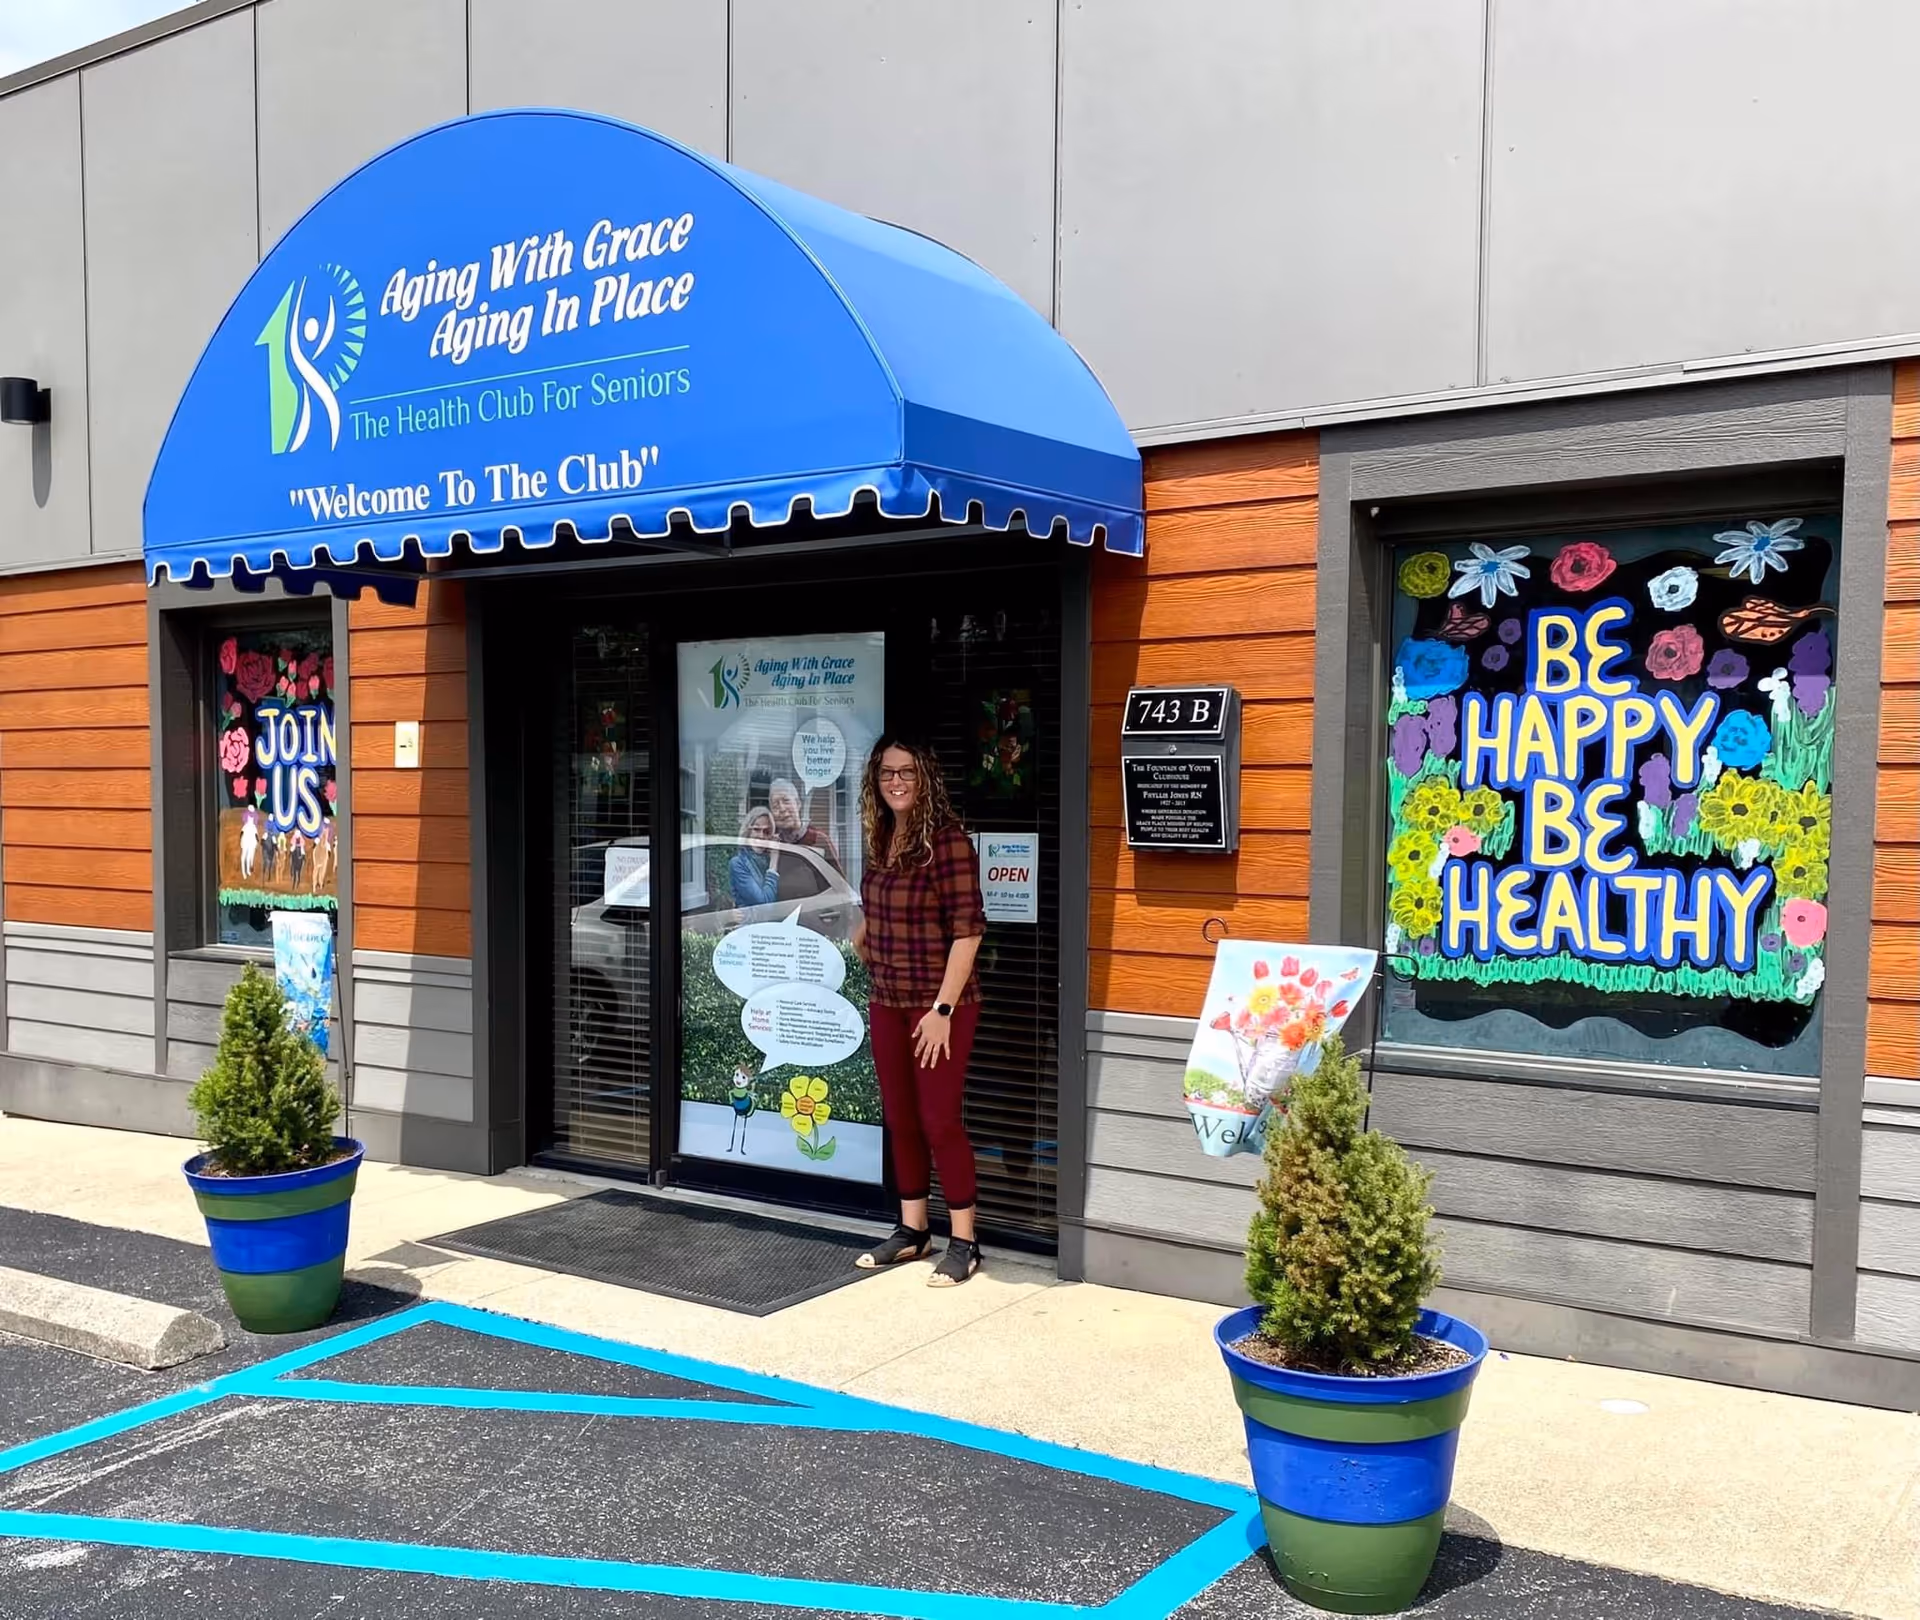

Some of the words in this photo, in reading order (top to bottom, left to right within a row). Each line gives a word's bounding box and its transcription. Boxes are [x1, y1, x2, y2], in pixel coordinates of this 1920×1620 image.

[380, 260, 479, 321] Aging
[490, 230, 572, 291] With
[584, 212, 694, 270] Grace
[430, 302, 534, 364] Aging
[541, 288, 583, 337] In
[589, 272, 695, 326] Place
[350, 412, 390, 440] The
[397, 397, 471, 434] Health
[478, 387, 534, 422] Club
[543, 380, 582, 413] For
[591, 368, 691, 406] Seniors
[290, 484, 430, 522] "Welcome
[439, 470, 475, 508] To
[485, 463, 548, 501] The
[557, 446, 659, 495] Club"
[754, 659, 788, 675] Aging
[792, 657, 818, 670] With
[821, 655, 855, 669] Grace
[771, 673, 805, 690] Aging
[808, 673, 820, 685] In
[823, 672, 855, 685] Place
[1532, 602, 1638, 698] BE
[256, 704, 336, 767] JOIN
[802, 734, 816, 743] We
[818, 734, 836, 745] help
[1139, 699, 1181, 724] 743
[1189, 699, 1210, 723] B
[1463, 693, 1718, 787] HAPPY
[807, 756, 831, 765] better
[273, 763, 321, 834] US
[1529, 780, 1635, 875] BE
[988, 867, 1030, 882] OPEN
[1446, 863, 1770, 966] HEALTHY
